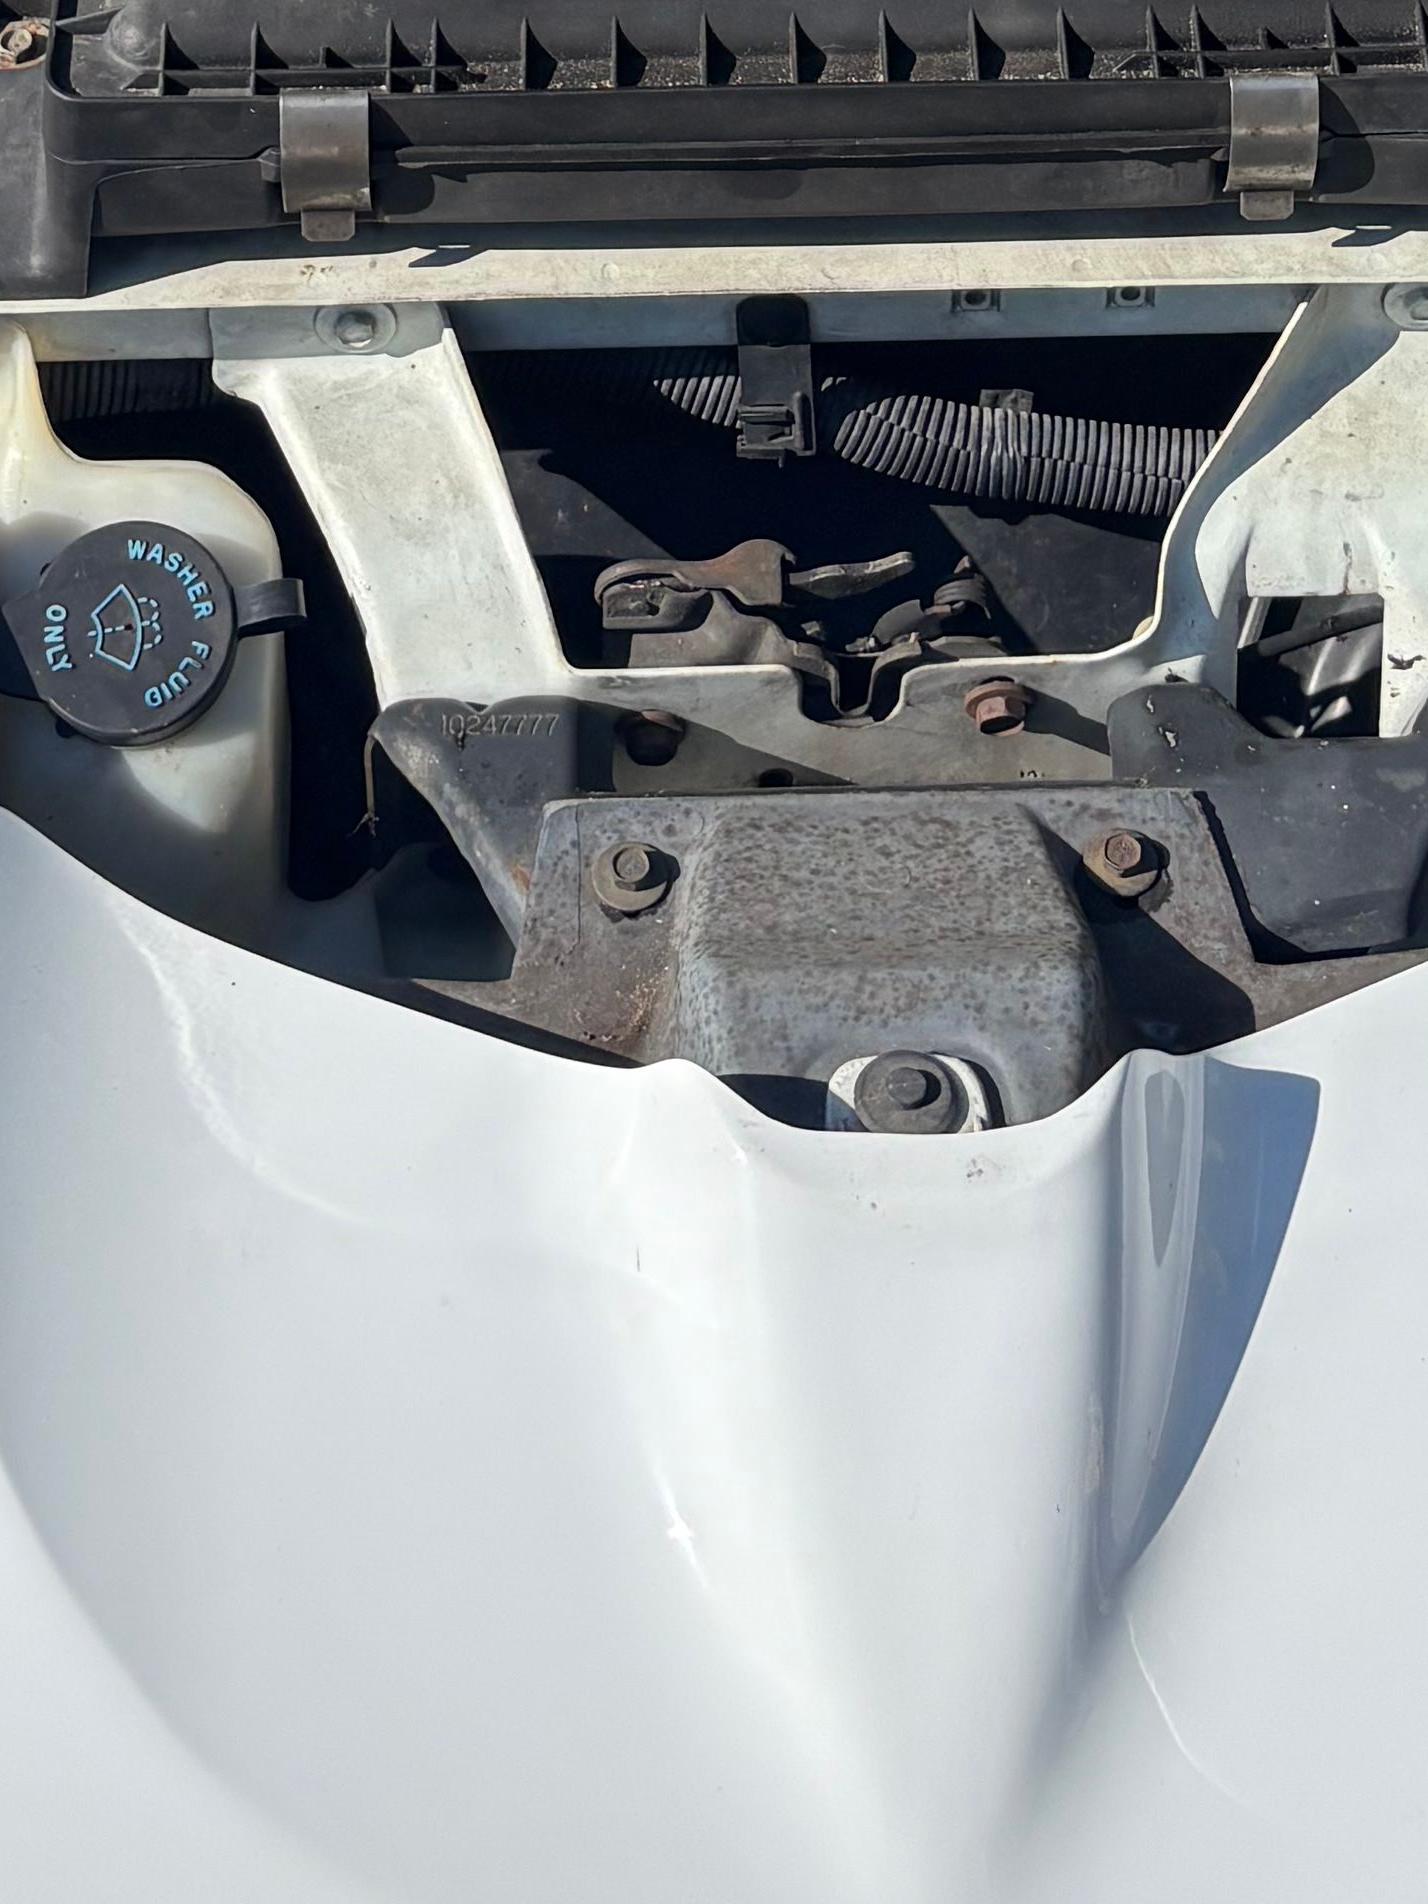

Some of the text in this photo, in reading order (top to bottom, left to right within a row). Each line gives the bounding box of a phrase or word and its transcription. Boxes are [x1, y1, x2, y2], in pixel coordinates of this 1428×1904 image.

[43, 538, 217, 710] WASHER FLUID ONLY
[441, 712, 560, 738] 10247777
